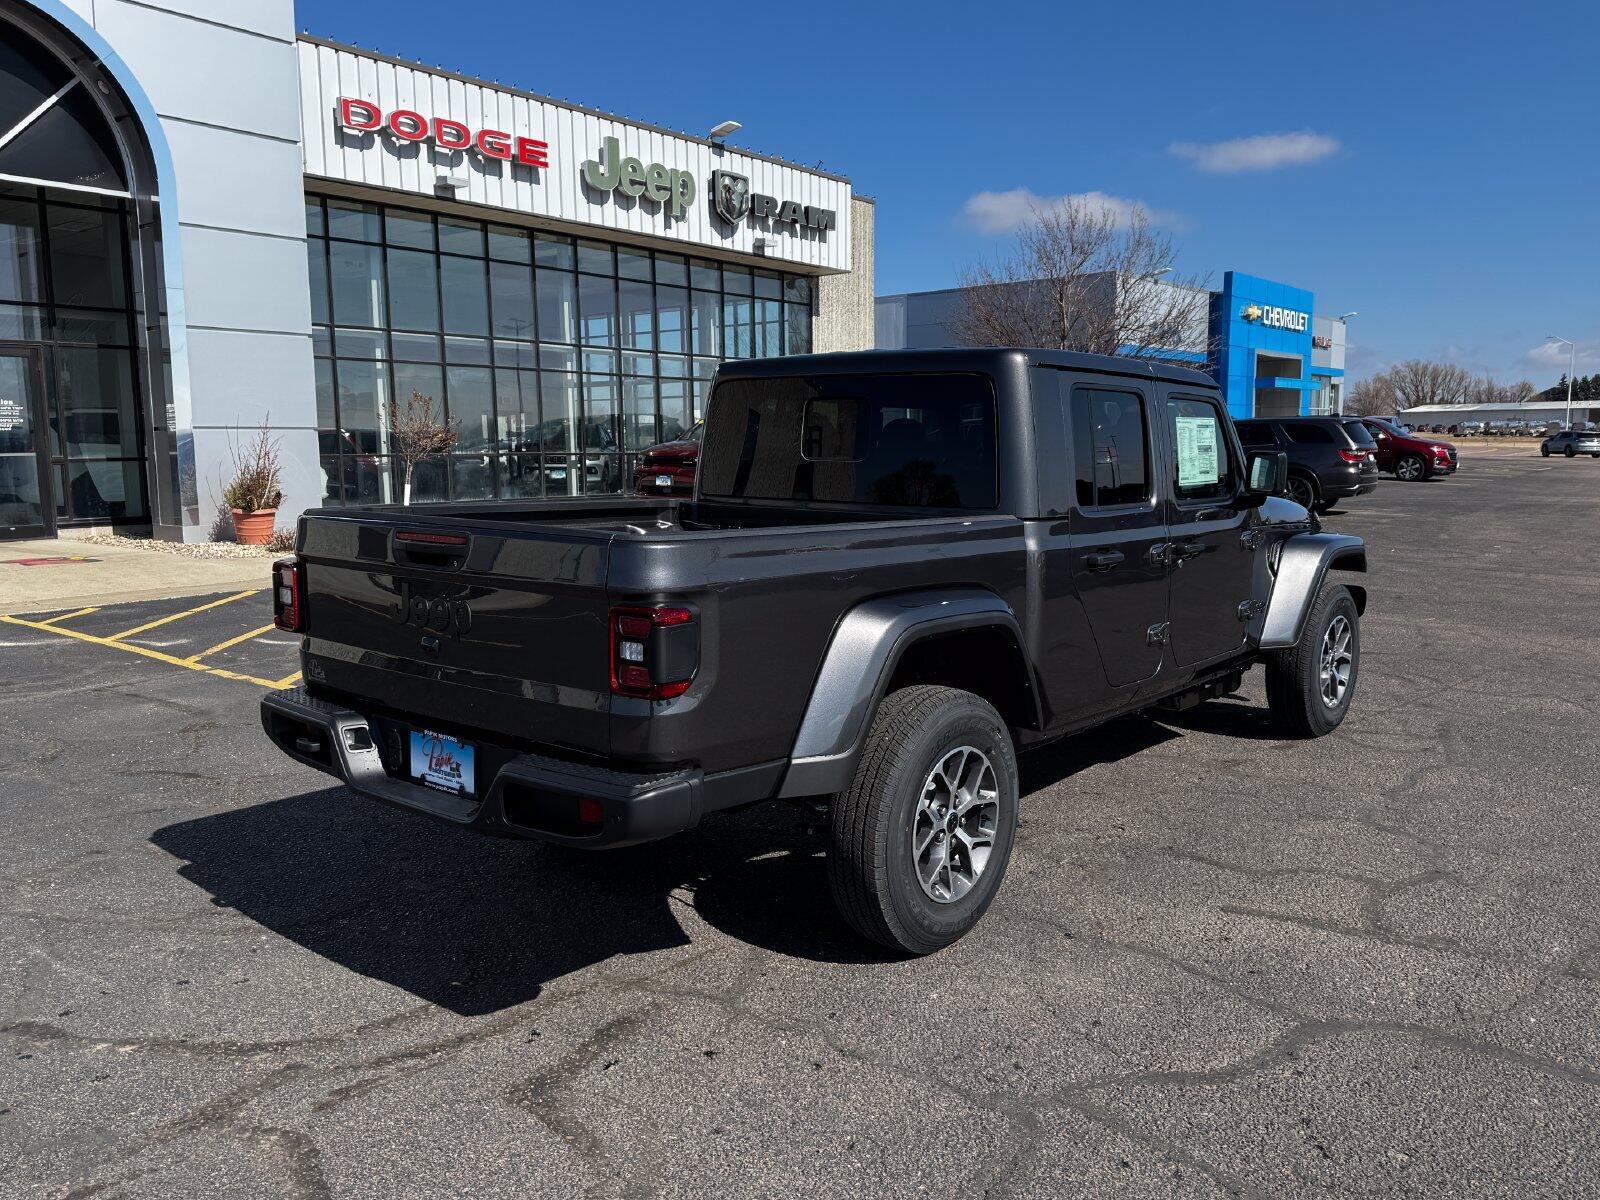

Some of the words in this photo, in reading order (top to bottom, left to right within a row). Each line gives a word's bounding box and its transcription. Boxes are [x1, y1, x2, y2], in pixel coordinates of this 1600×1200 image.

[338, 97, 549, 168] DODGE
[583, 136, 696, 216] Jeep
[752, 193, 836, 231] RAM
[1263, 305, 1309, 331] CHEVROLET
[392, 582, 473, 643] Jeep
